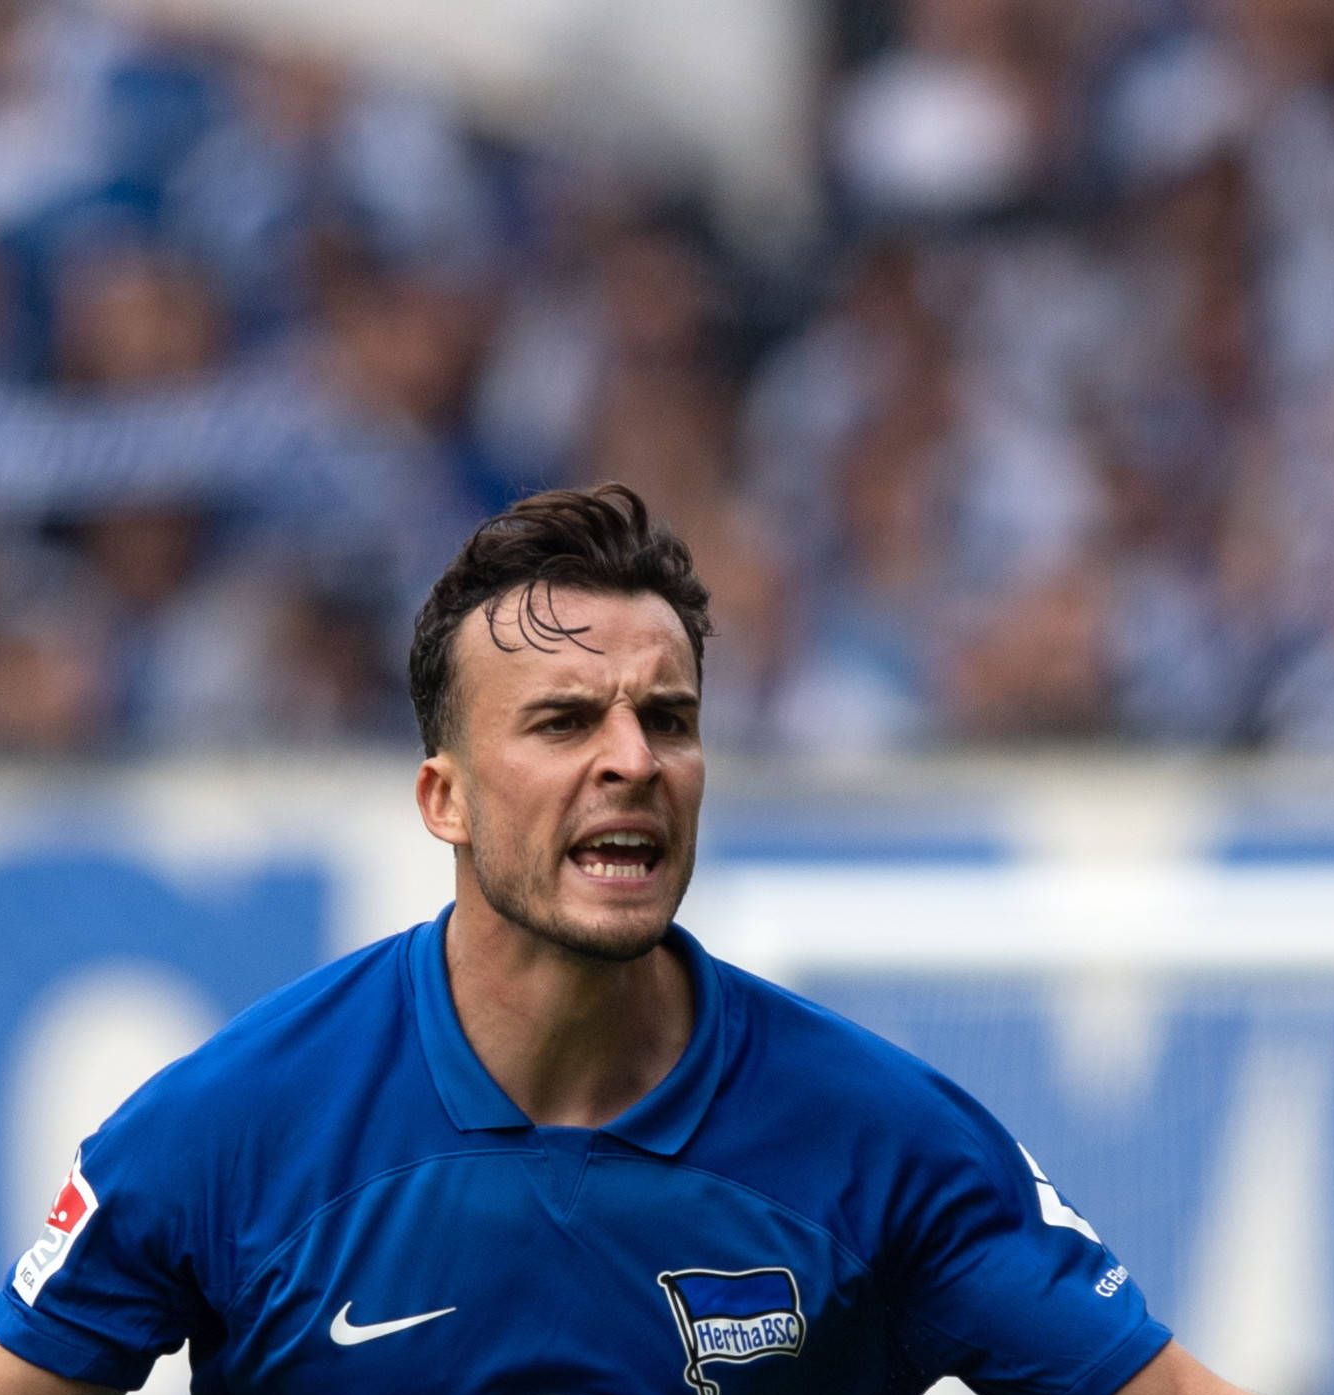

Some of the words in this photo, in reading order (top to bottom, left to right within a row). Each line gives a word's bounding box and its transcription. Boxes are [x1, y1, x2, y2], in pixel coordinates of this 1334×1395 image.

[1096, 1279, 1118, 1297] CG
[697, 1322, 763, 1353] Hertha
[761, 1316, 798, 1346] BSC
